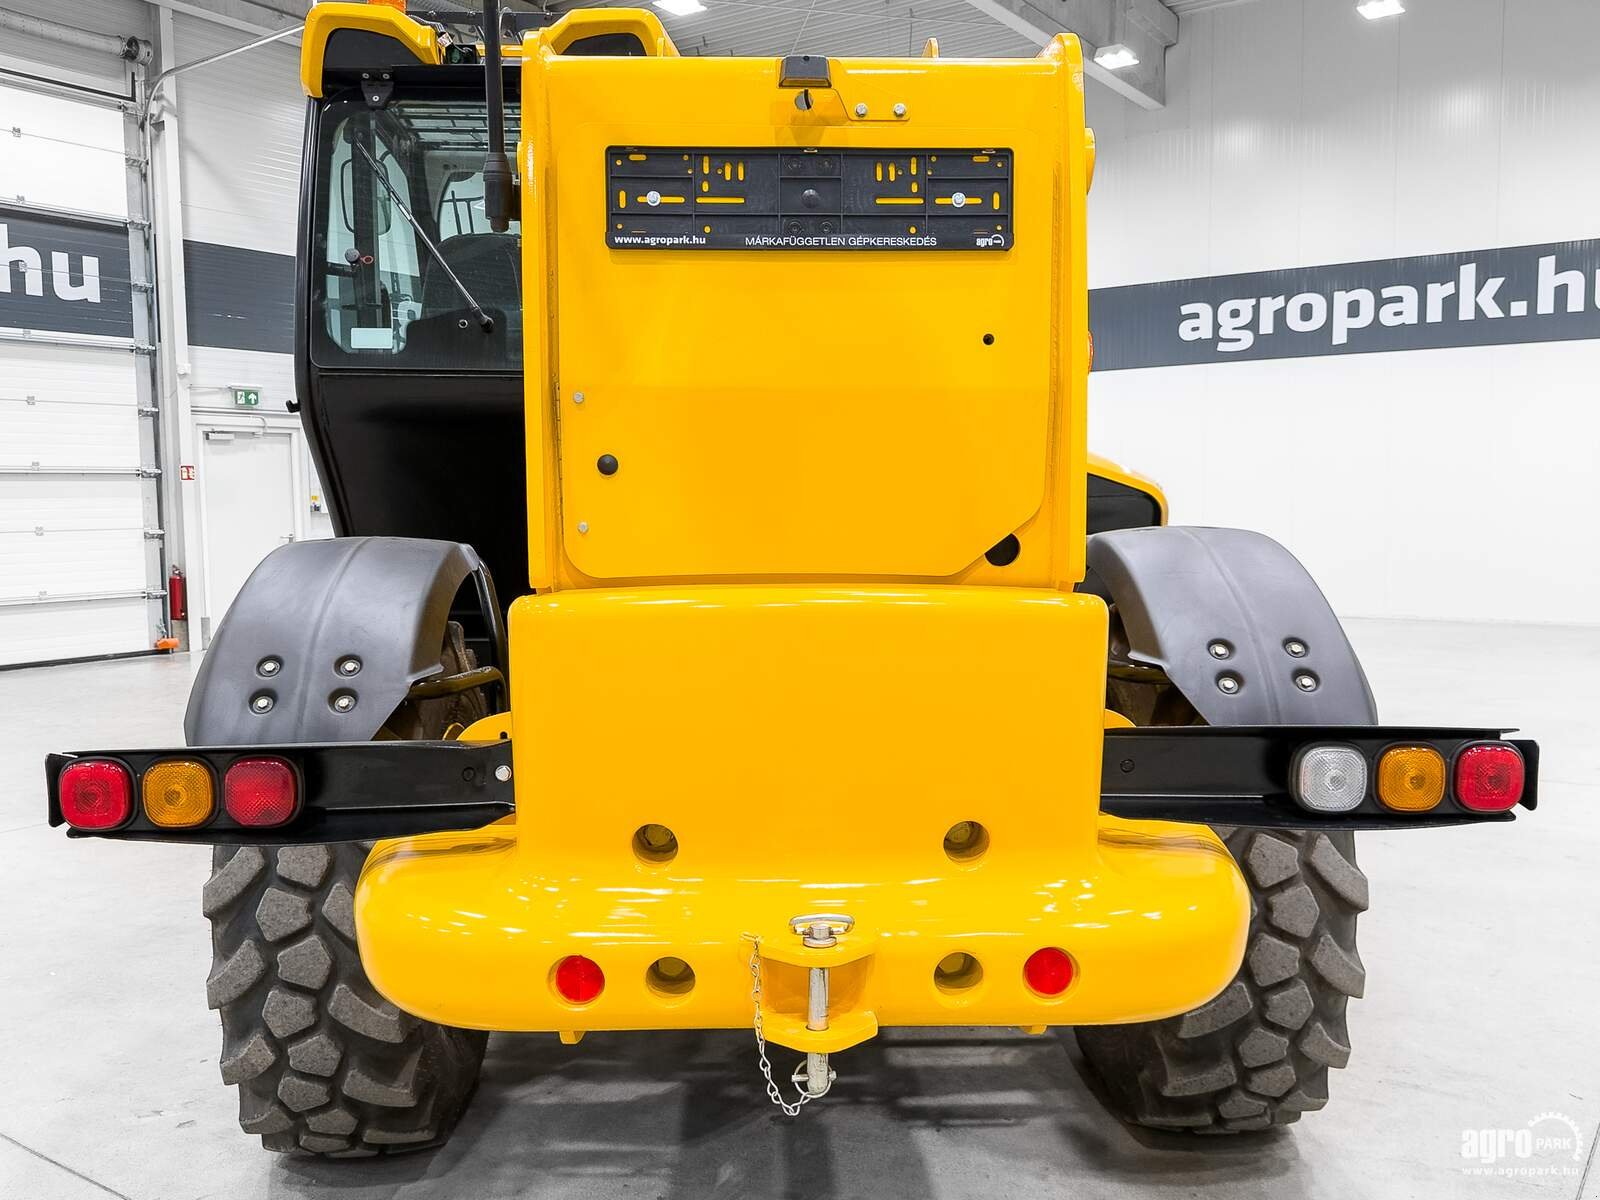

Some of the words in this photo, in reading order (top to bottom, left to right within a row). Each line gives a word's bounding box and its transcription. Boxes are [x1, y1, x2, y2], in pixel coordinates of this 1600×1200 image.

[614, 235, 706, 247] www.agropark.hu
[745, 234, 846, 247] MÁRKAFÜGGETLEN
[848, 235, 937, 247] GÉPKERESKEDÉS
[976, 237, 993, 248] agro
[1178, 255, 1600, 353] agropark.h
